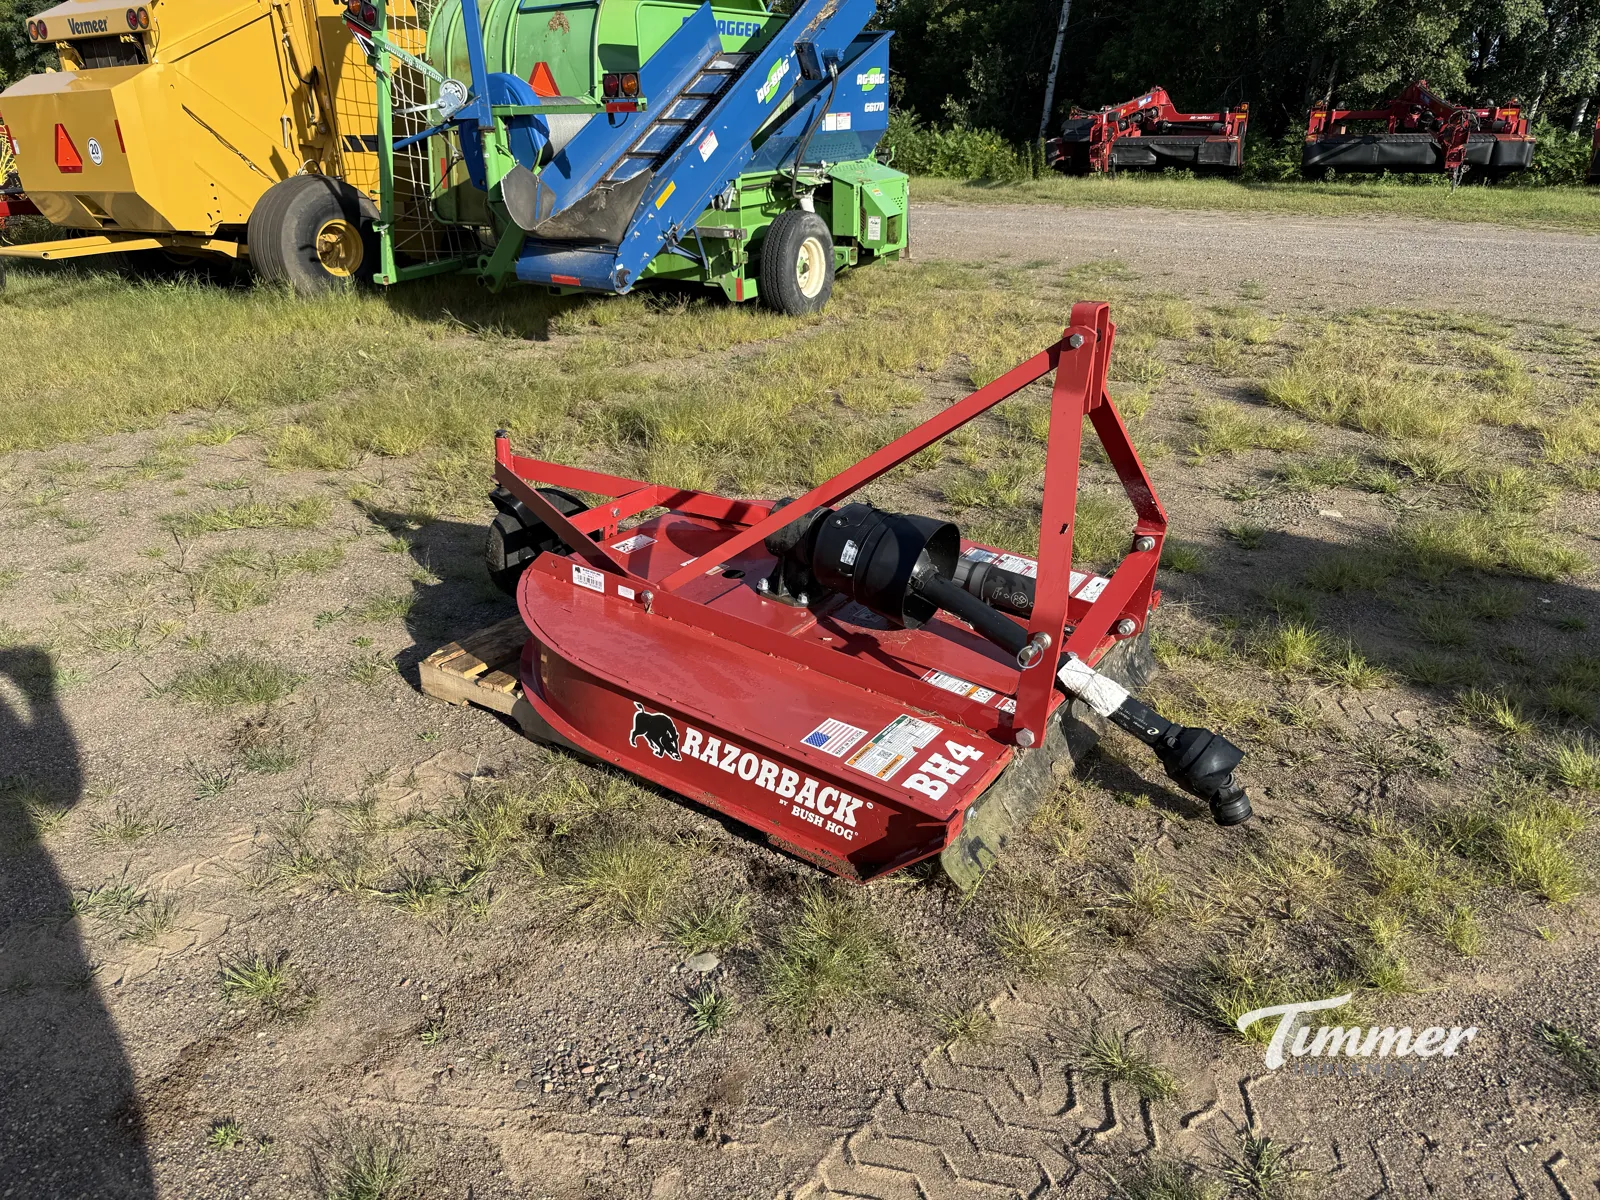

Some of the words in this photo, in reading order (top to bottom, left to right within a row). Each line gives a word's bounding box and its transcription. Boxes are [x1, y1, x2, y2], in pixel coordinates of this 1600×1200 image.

[67, 18, 108, 35] Vermeer
[717, 20, 761, 37] AGGER
[856, 73, 886, 86] AG-BAG
[864, 101, 885, 113] G6170
[90, 143, 99, 154] 20
[680, 726, 864, 828] RAZORBACK
[901, 740, 984, 801] BH4
[779, 798, 788, 806] BY
[791, 805, 825, 828] BUSH
[825, 820, 854, 841] HOG
